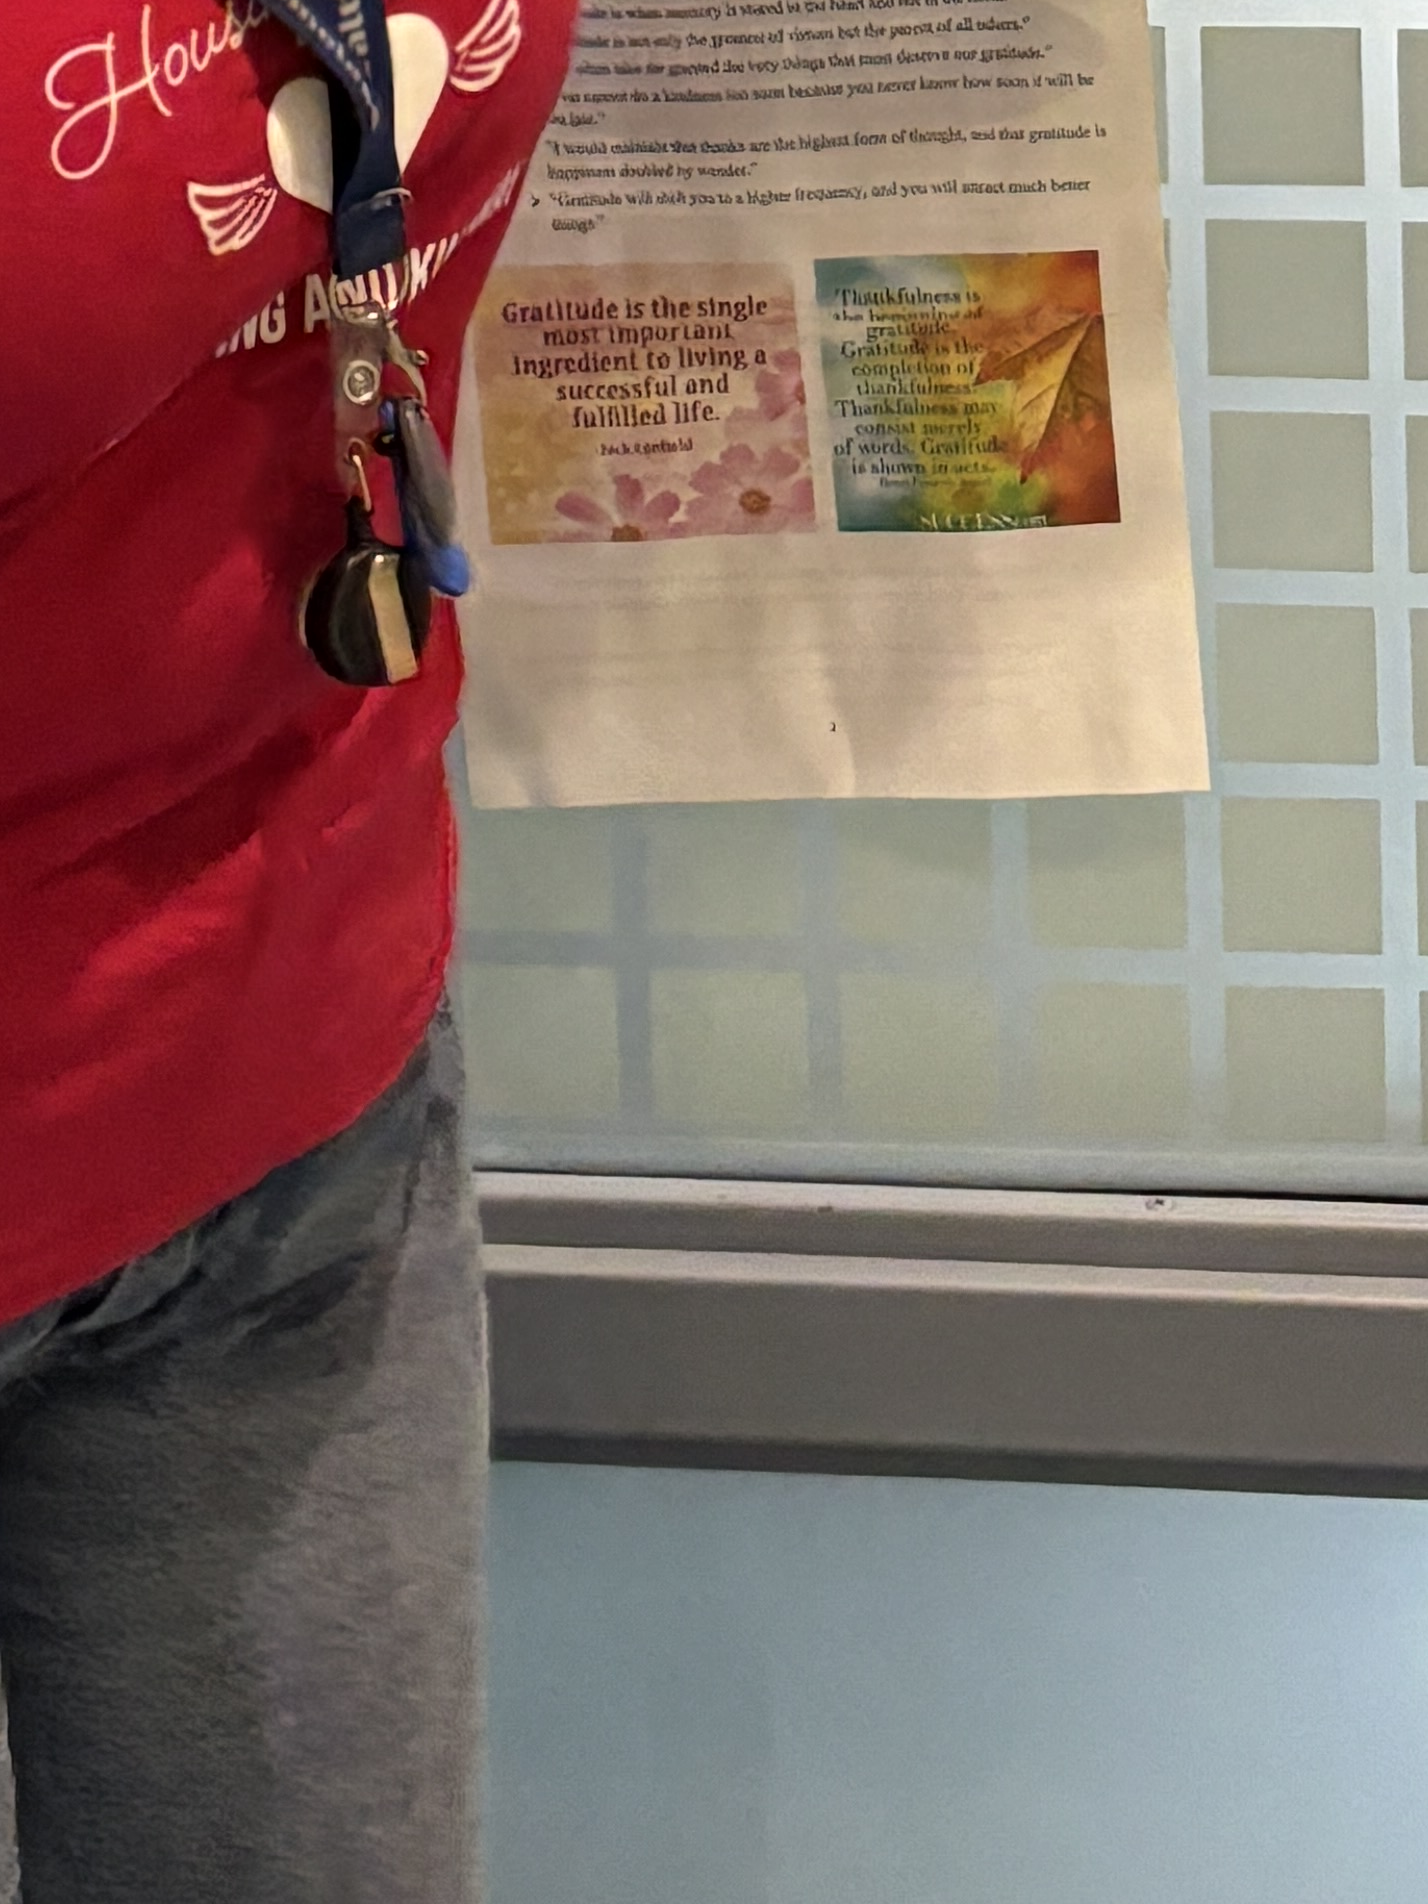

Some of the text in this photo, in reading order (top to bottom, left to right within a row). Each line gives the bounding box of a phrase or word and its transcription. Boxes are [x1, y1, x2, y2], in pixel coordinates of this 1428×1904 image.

[1095, 124, 1107, 138] is
[502, 294, 768, 323] Gratitude is the single
[543, 322, 735, 349] most important
[935, 340, 950, 356] is
[954, 337, 984, 354] the
[647, 348, 671, 370] to
[679, 346, 748, 370] living
[753, 348, 768, 365] a
[852, 360, 951, 381] completion
[556, 373, 730, 401] successful and
[572, 400, 721, 429] fulfilled life.
[835, 399, 999, 418] Thankfulness may
[833, 439, 851, 457] of
[920, 436, 1006, 455] Gratitude
[851, 460, 865, 474] is
[870, 458, 925, 476] shown
